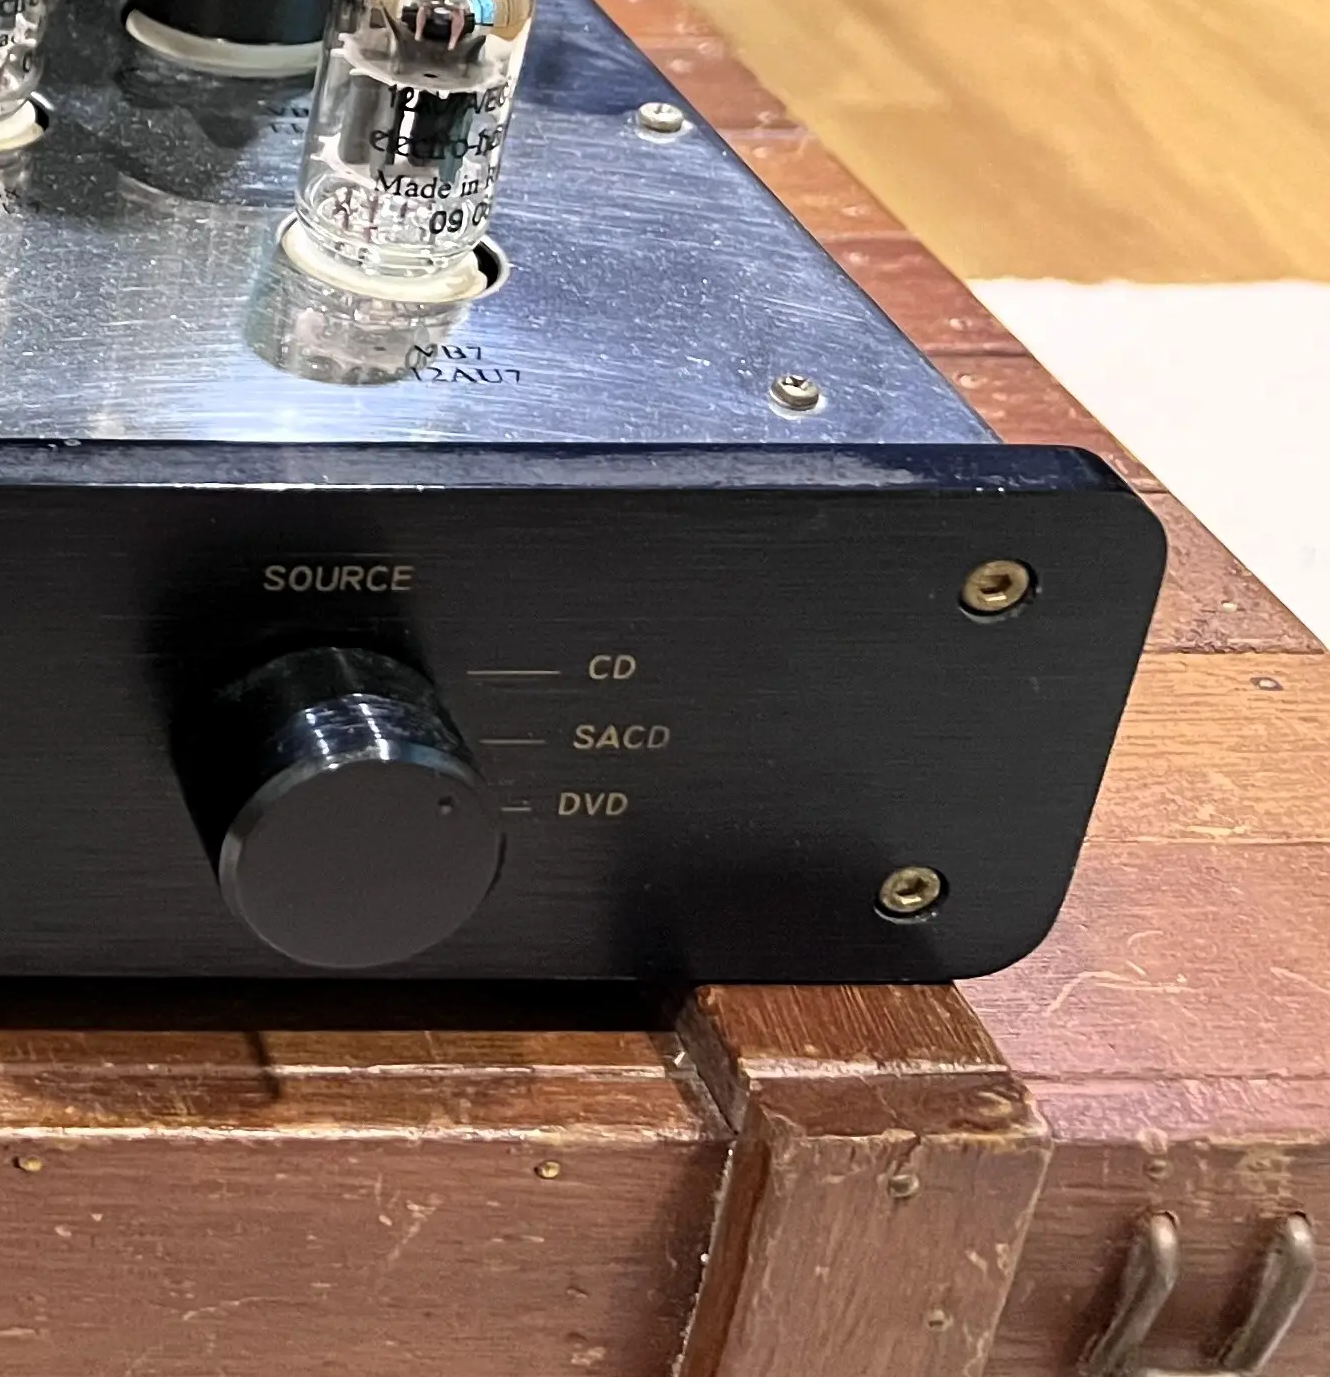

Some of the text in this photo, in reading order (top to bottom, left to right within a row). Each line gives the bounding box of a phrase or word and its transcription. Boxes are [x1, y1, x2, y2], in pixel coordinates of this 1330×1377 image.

[374, 169, 452, 199] Made
[460, 174, 480, 197] in
[428, 209, 464, 235] 09
[413, 344, 481, 361] VB7
[408, 365, 522, 385] 12AU7
[262, 565, 415, 592] SOURCE
[588, 654, 637, 680] CD
[572, 724, 670, 750] SACD
[557, 792, 629, 817] DVD
